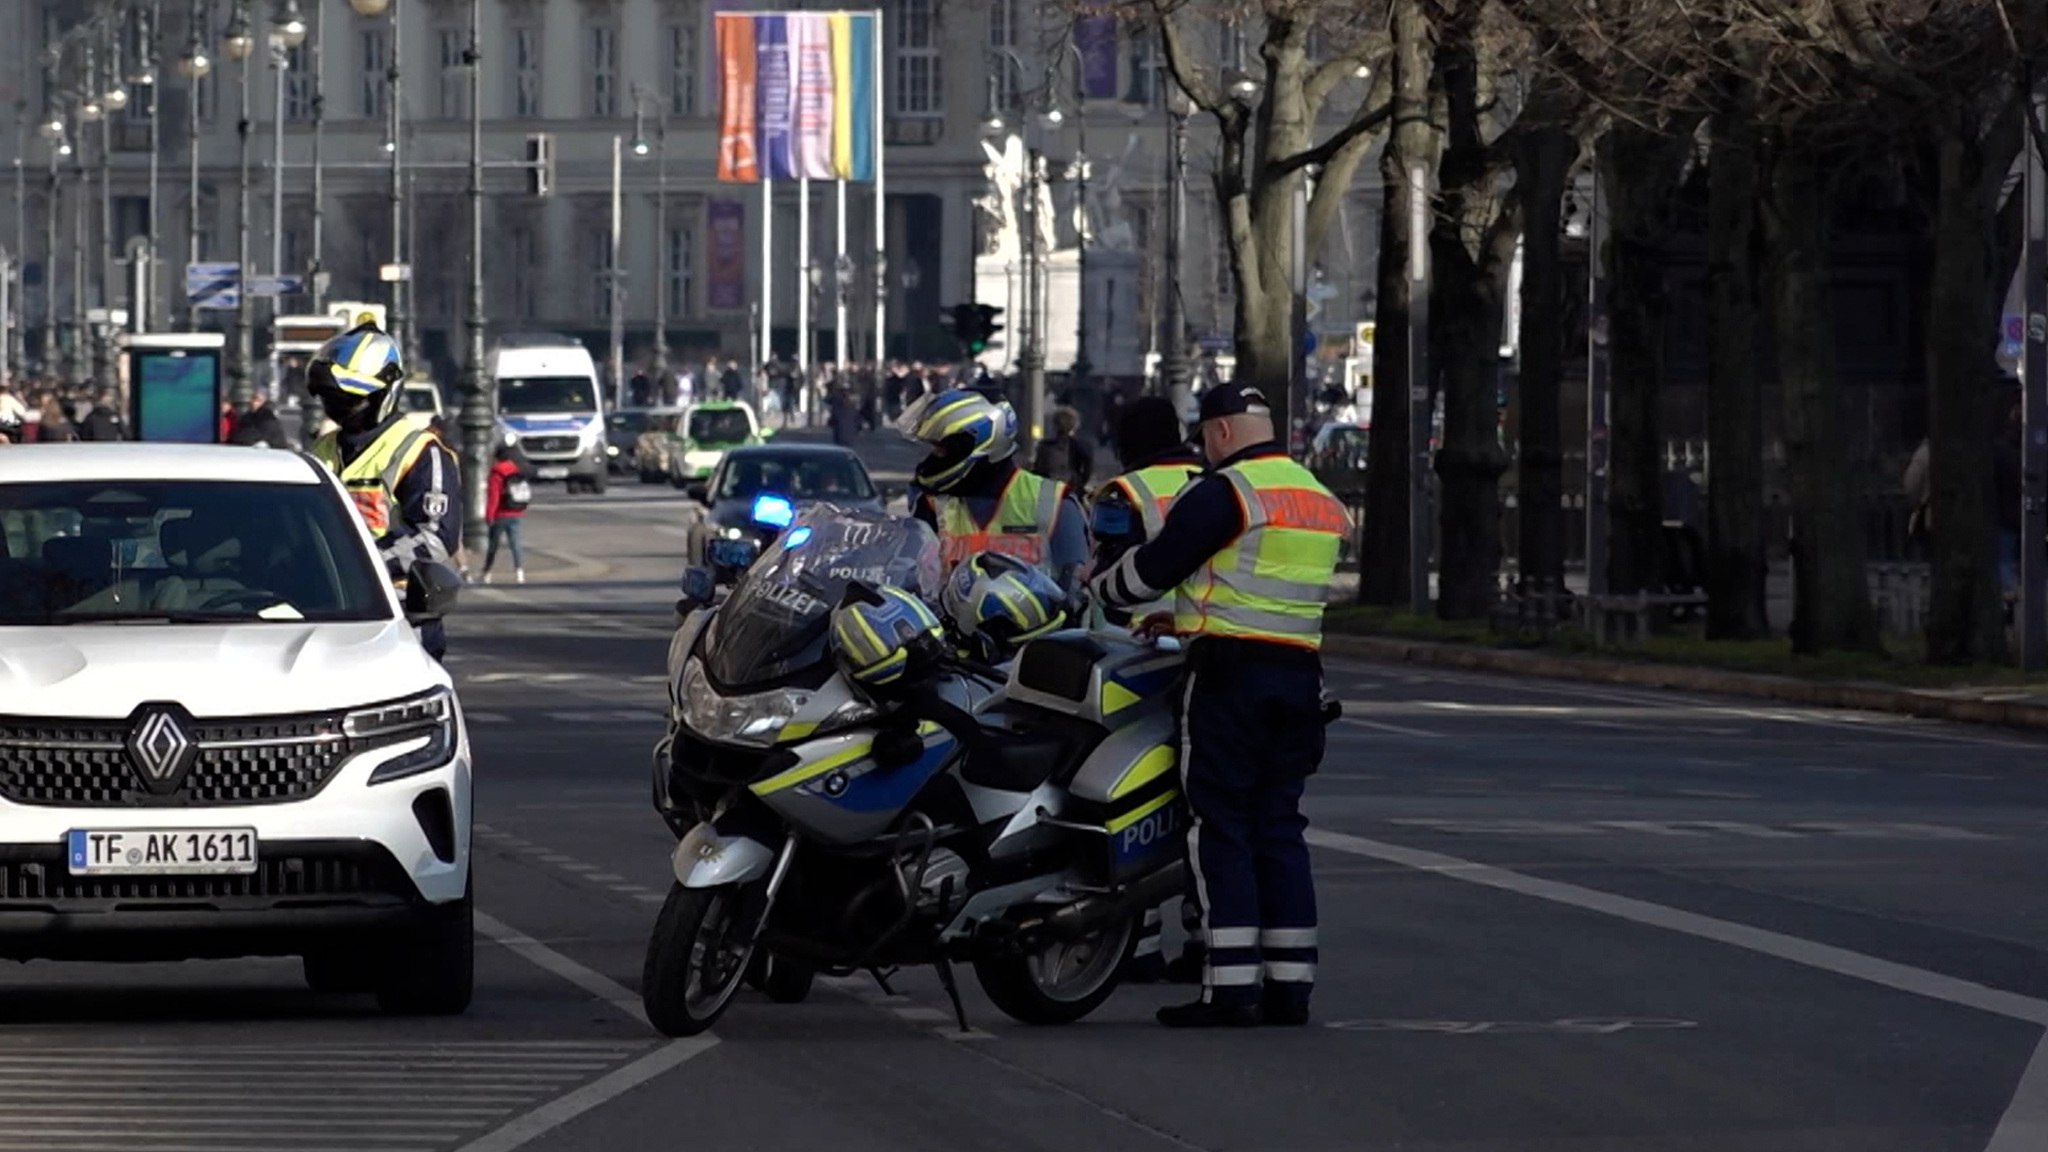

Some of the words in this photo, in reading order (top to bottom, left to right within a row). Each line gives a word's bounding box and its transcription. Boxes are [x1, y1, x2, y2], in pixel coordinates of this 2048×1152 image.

[829, 566, 892, 585] POLIZEI
[1123, 806, 1181, 853] POLI
[89, 834, 123, 863] TF
[146, 834, 178, 863] AK
[186, 834, 253, 862] 1611
